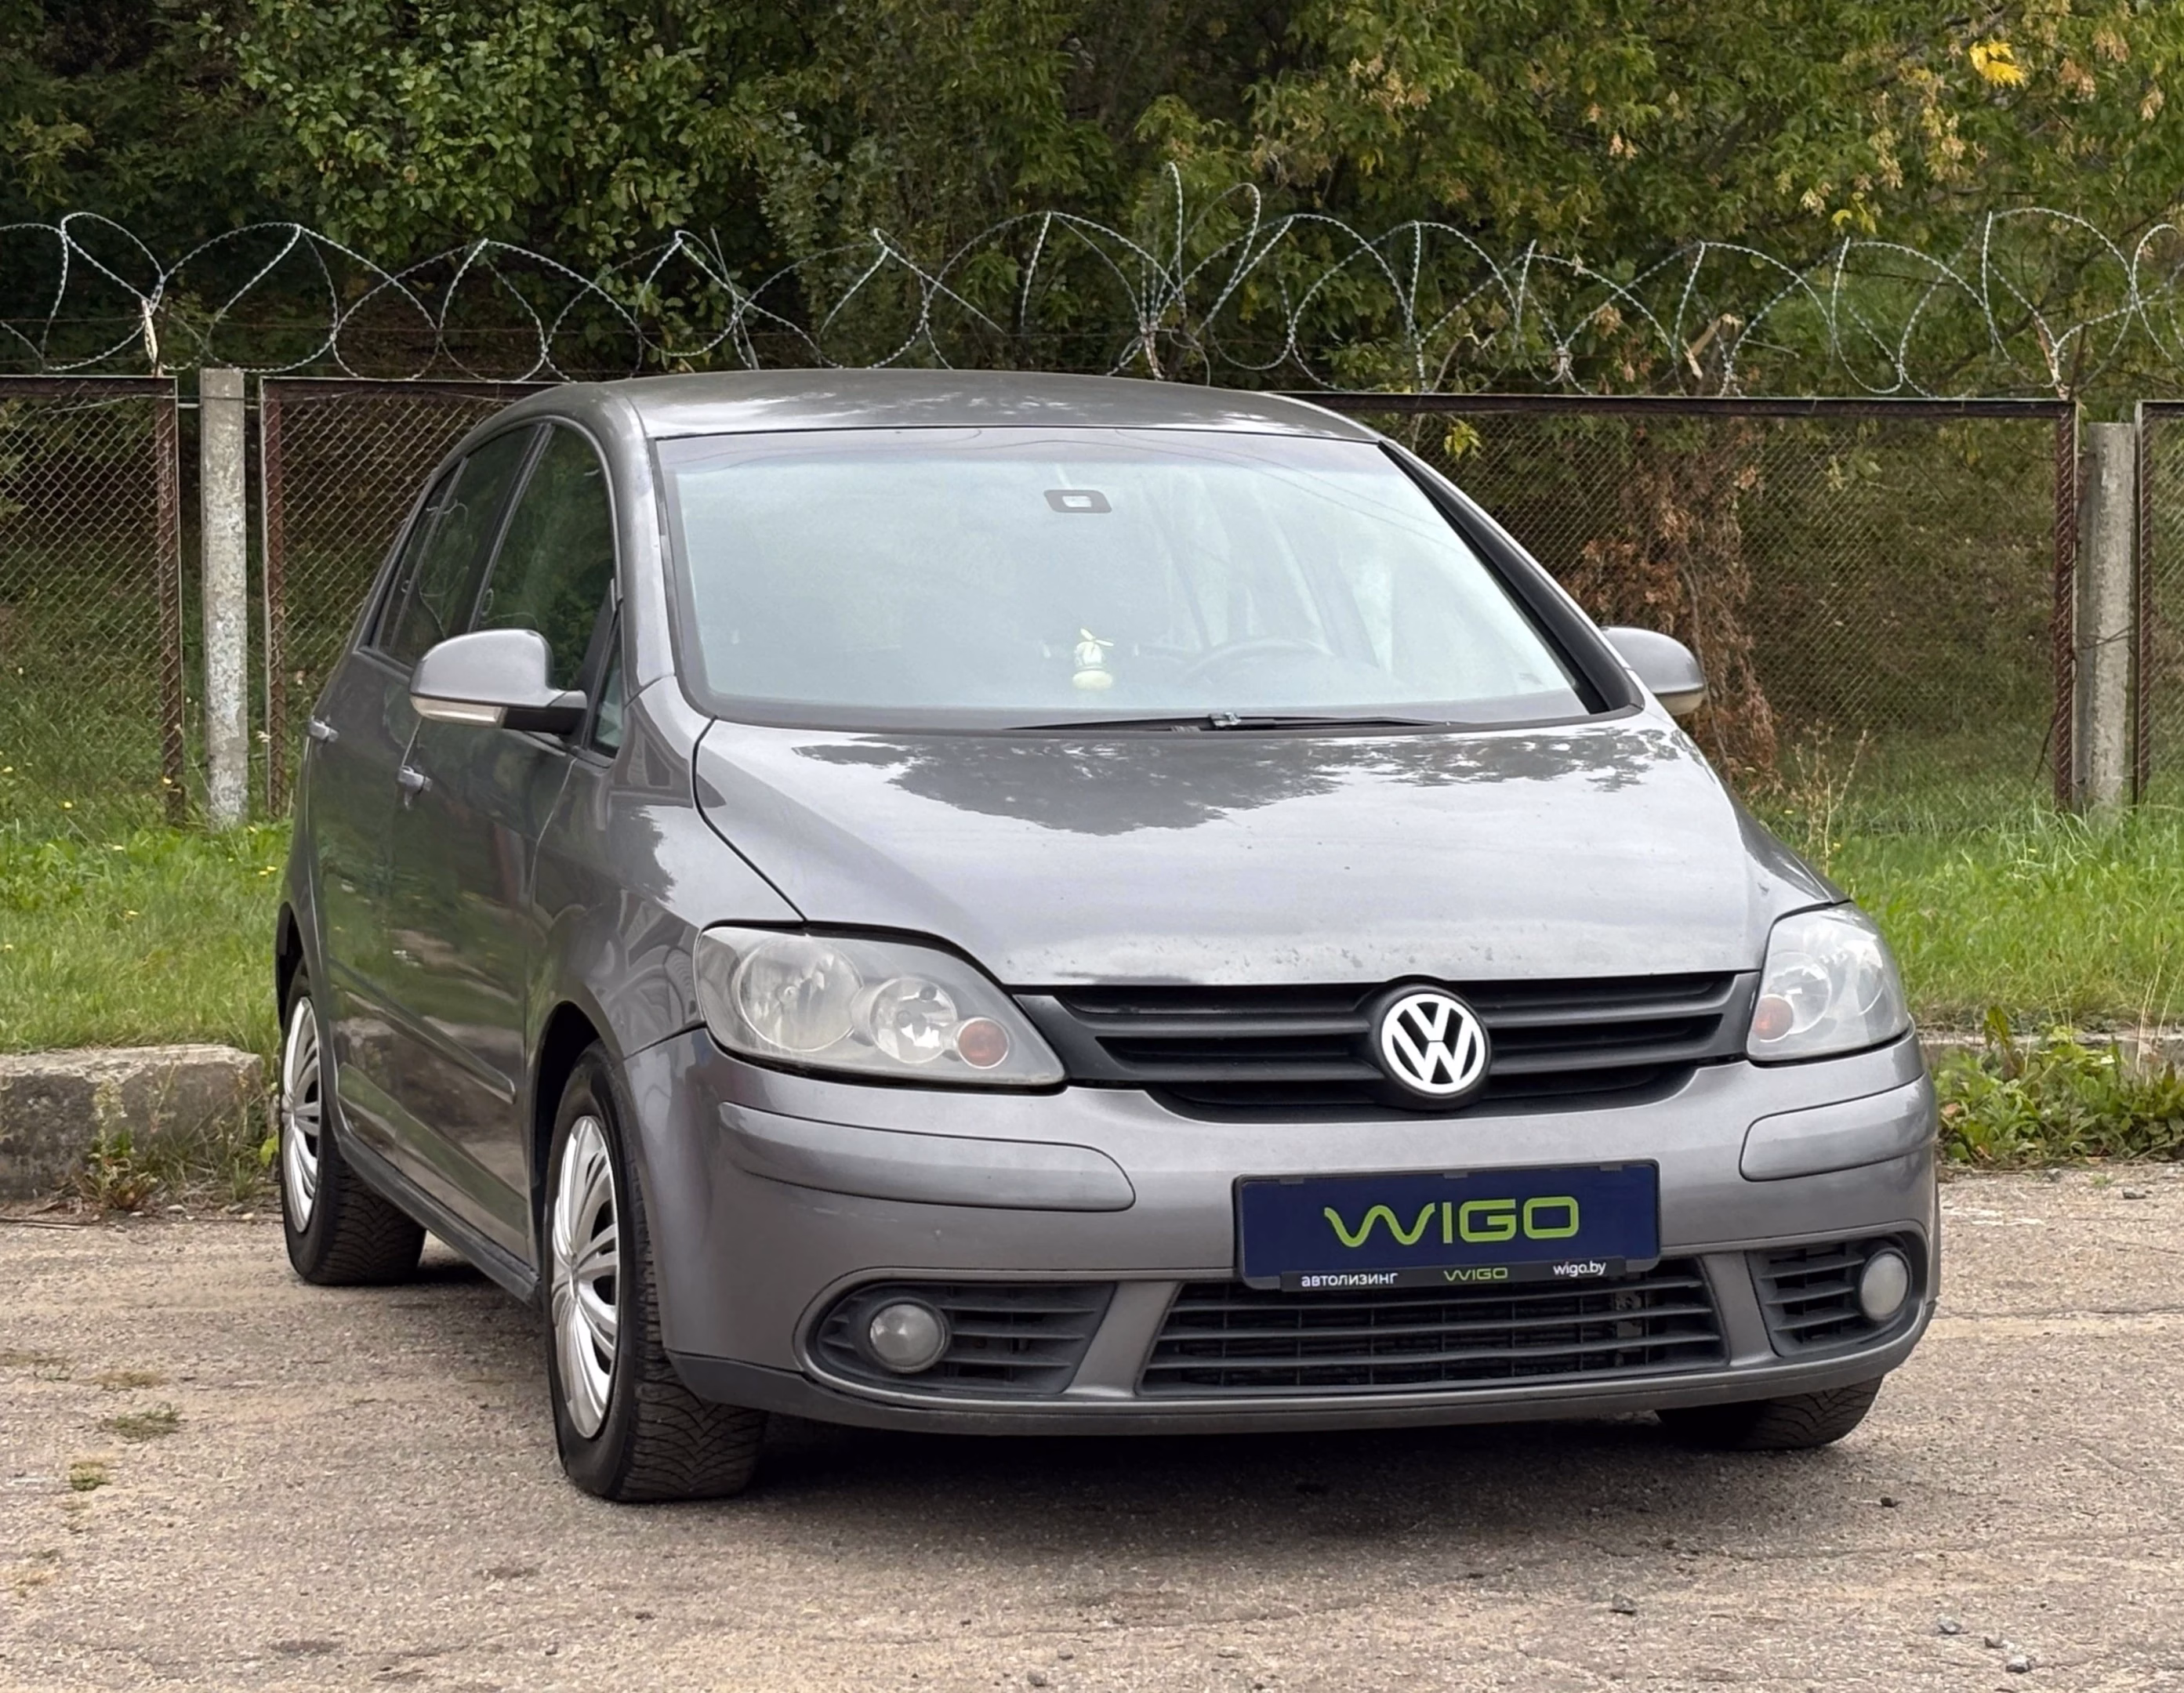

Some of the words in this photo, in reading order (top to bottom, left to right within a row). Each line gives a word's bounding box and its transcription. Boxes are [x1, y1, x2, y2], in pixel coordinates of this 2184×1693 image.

[1384, 995, 1483, 1092] VW
[1323, 1195, 1580, 1248] WIGO
[1301, 1273, 1399, 1287] автолизинг
[1443, 1267, 1508, 1282] WIGO
[1552, 1260, 1607, 1278] wigo.by
